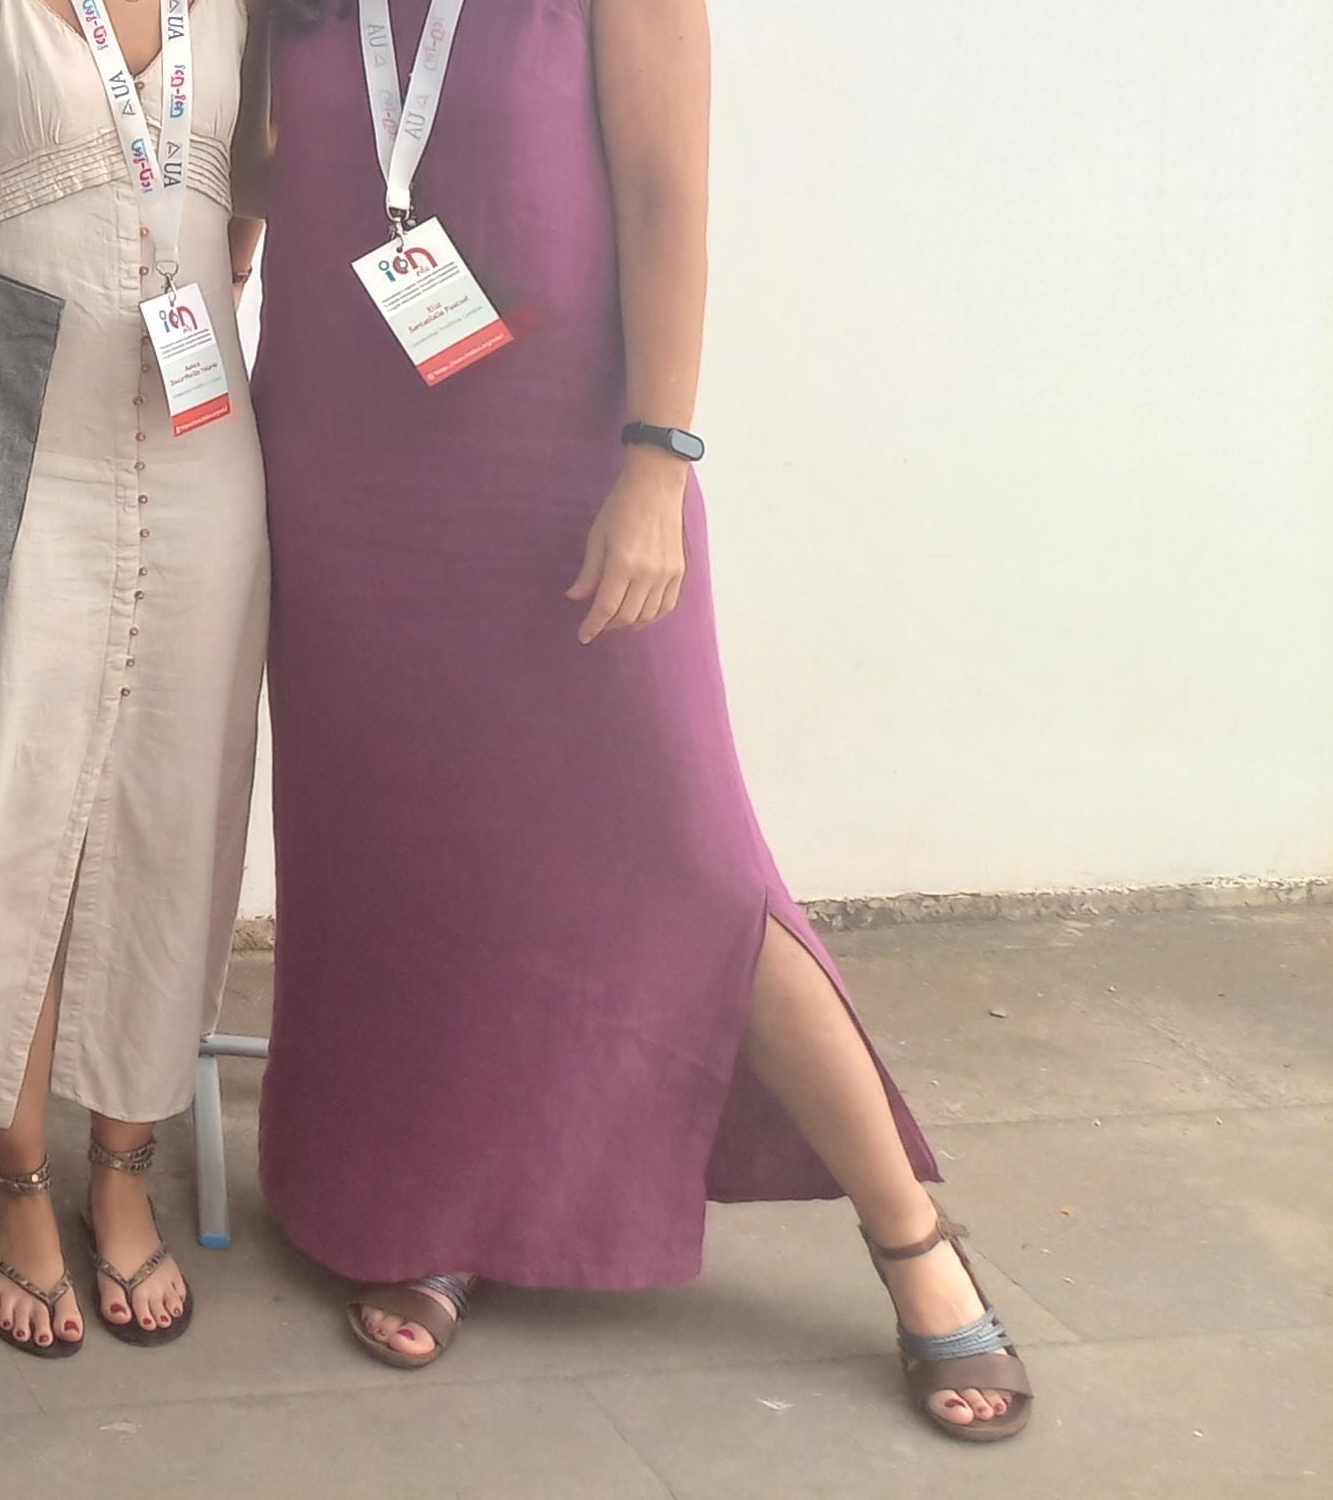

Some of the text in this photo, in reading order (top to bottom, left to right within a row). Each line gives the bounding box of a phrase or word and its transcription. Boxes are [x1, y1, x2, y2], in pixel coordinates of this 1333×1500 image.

[167, 15, 185, 42] UA
[108, 68, 133, 102] UA
[162, 160, 183, 189] UA
[377, 245, 439, 283] icon
